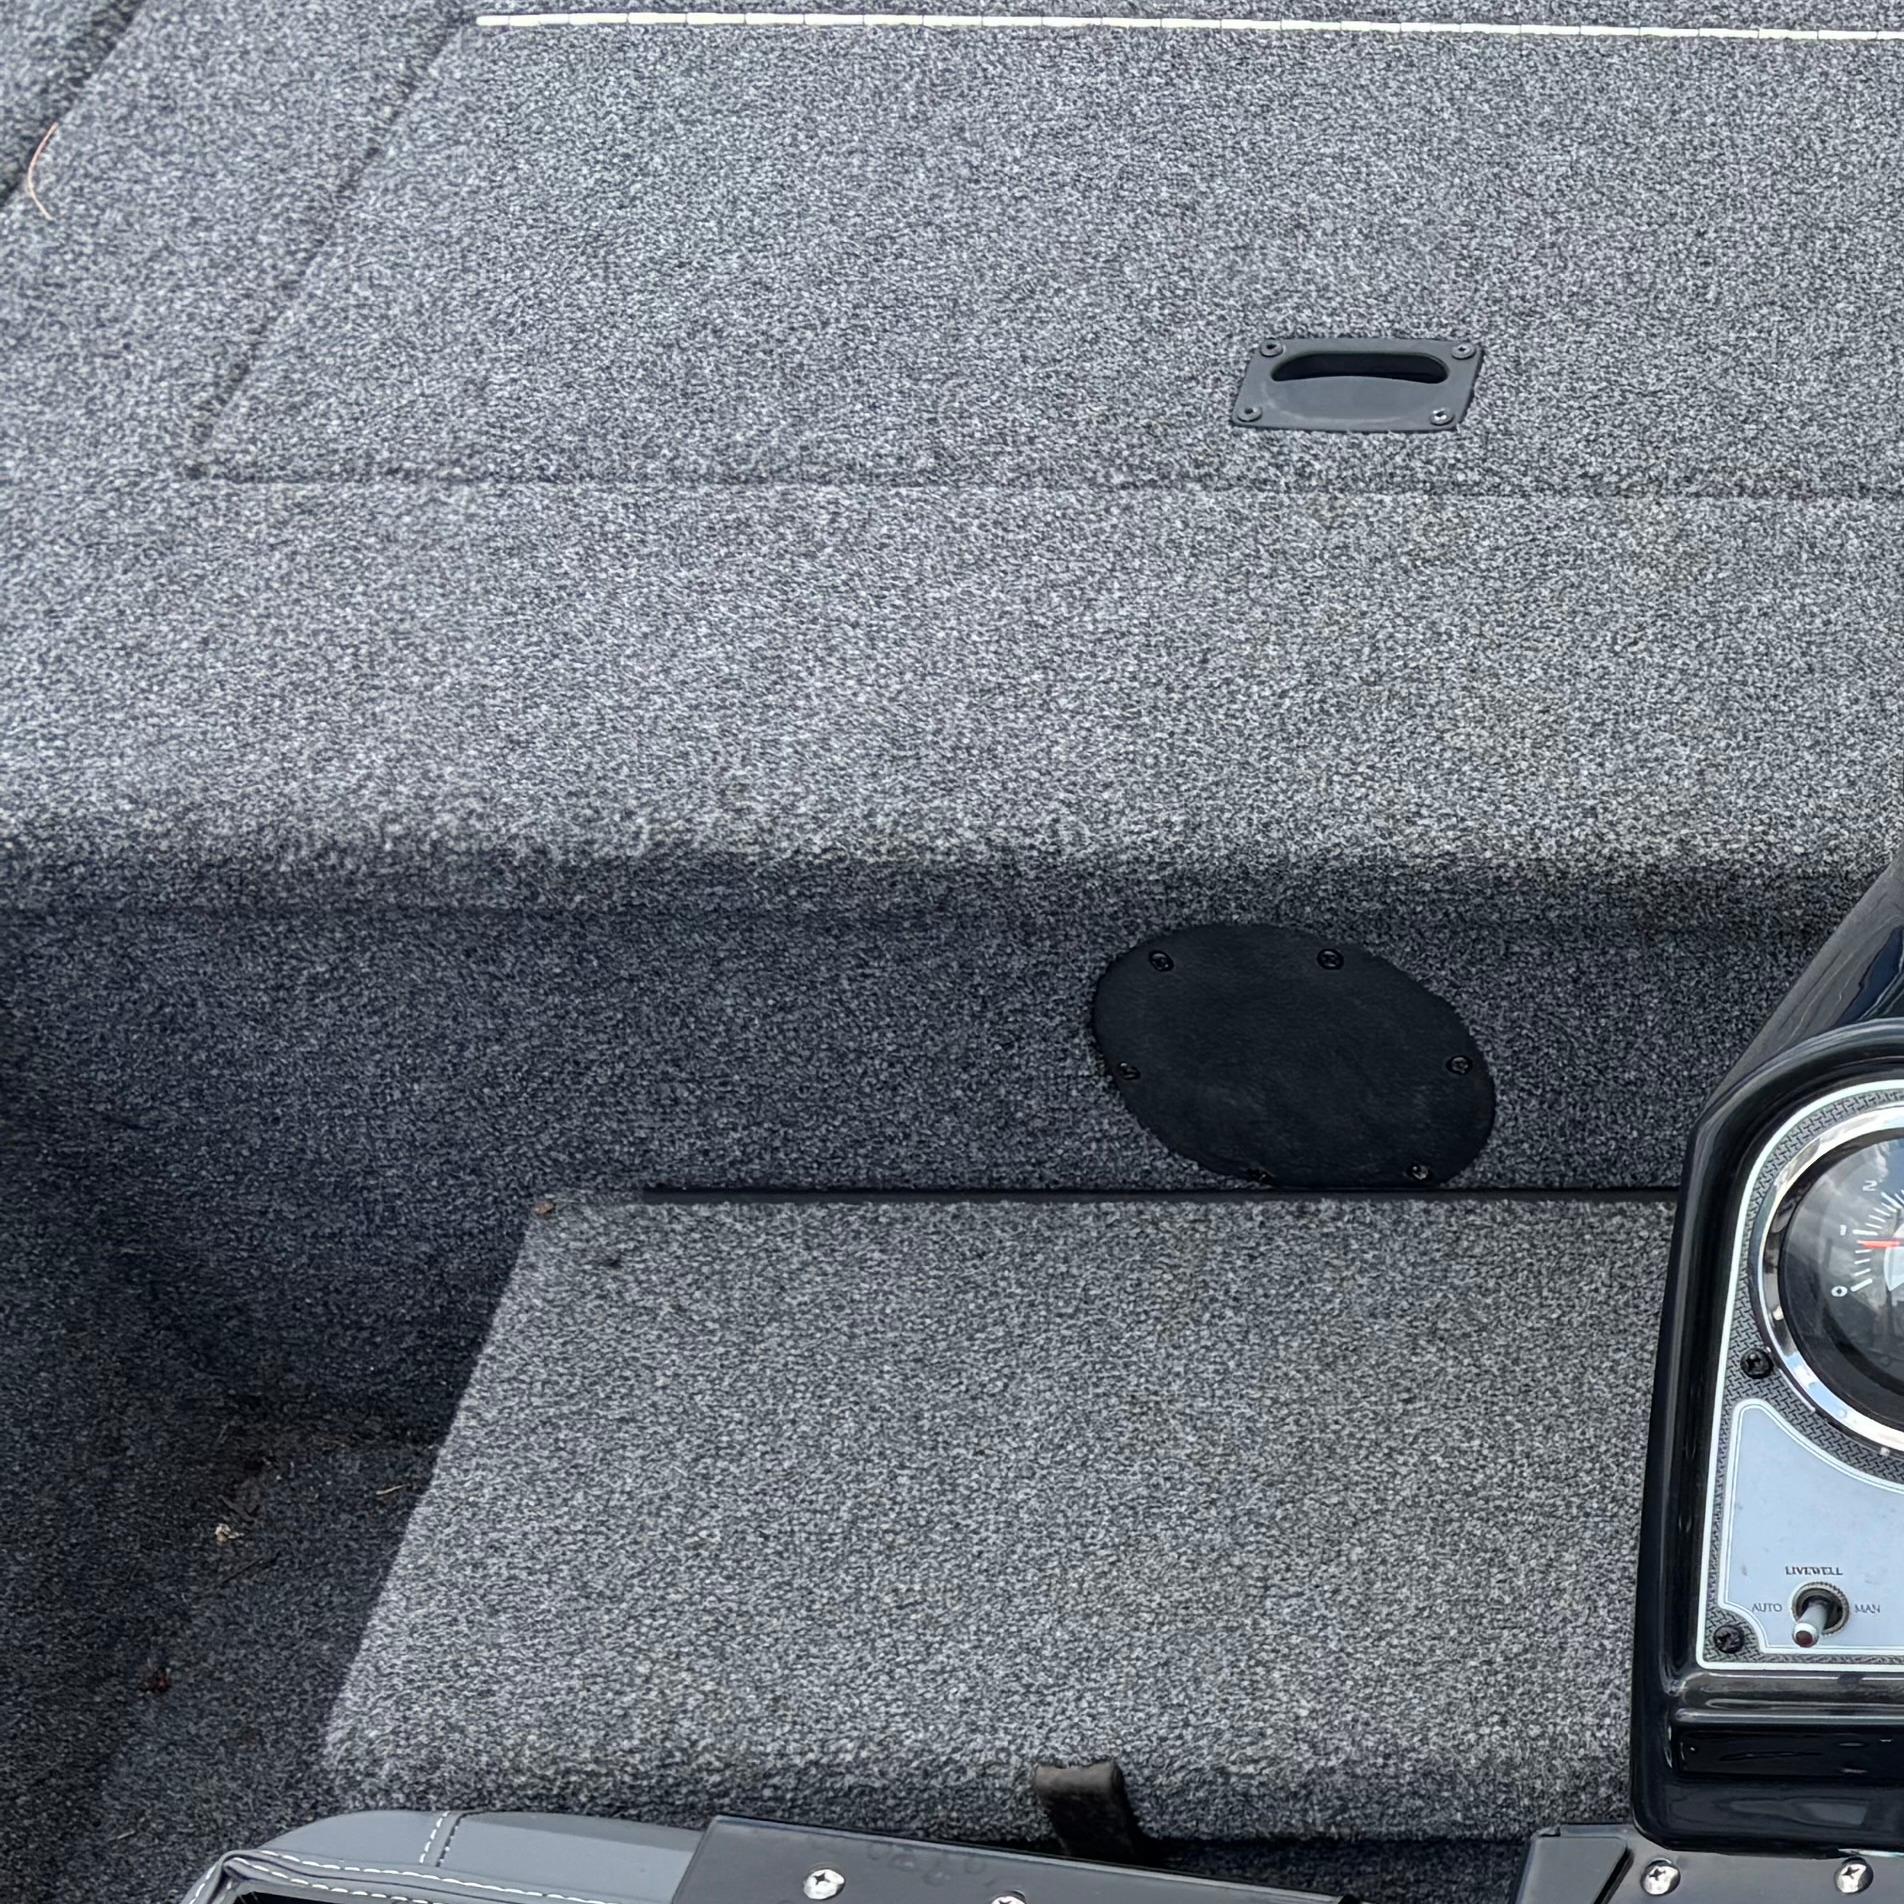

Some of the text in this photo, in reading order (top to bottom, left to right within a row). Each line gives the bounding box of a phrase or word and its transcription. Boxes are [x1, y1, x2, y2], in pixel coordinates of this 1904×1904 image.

[1862, 1180, 1878, 1191] 2
[1831, 1285, 1848, 1297] 0
[1785, 1566, 1843, 1576] LIVEWELL
[1752, 1603, 1880, 1614] AUTO MAN
